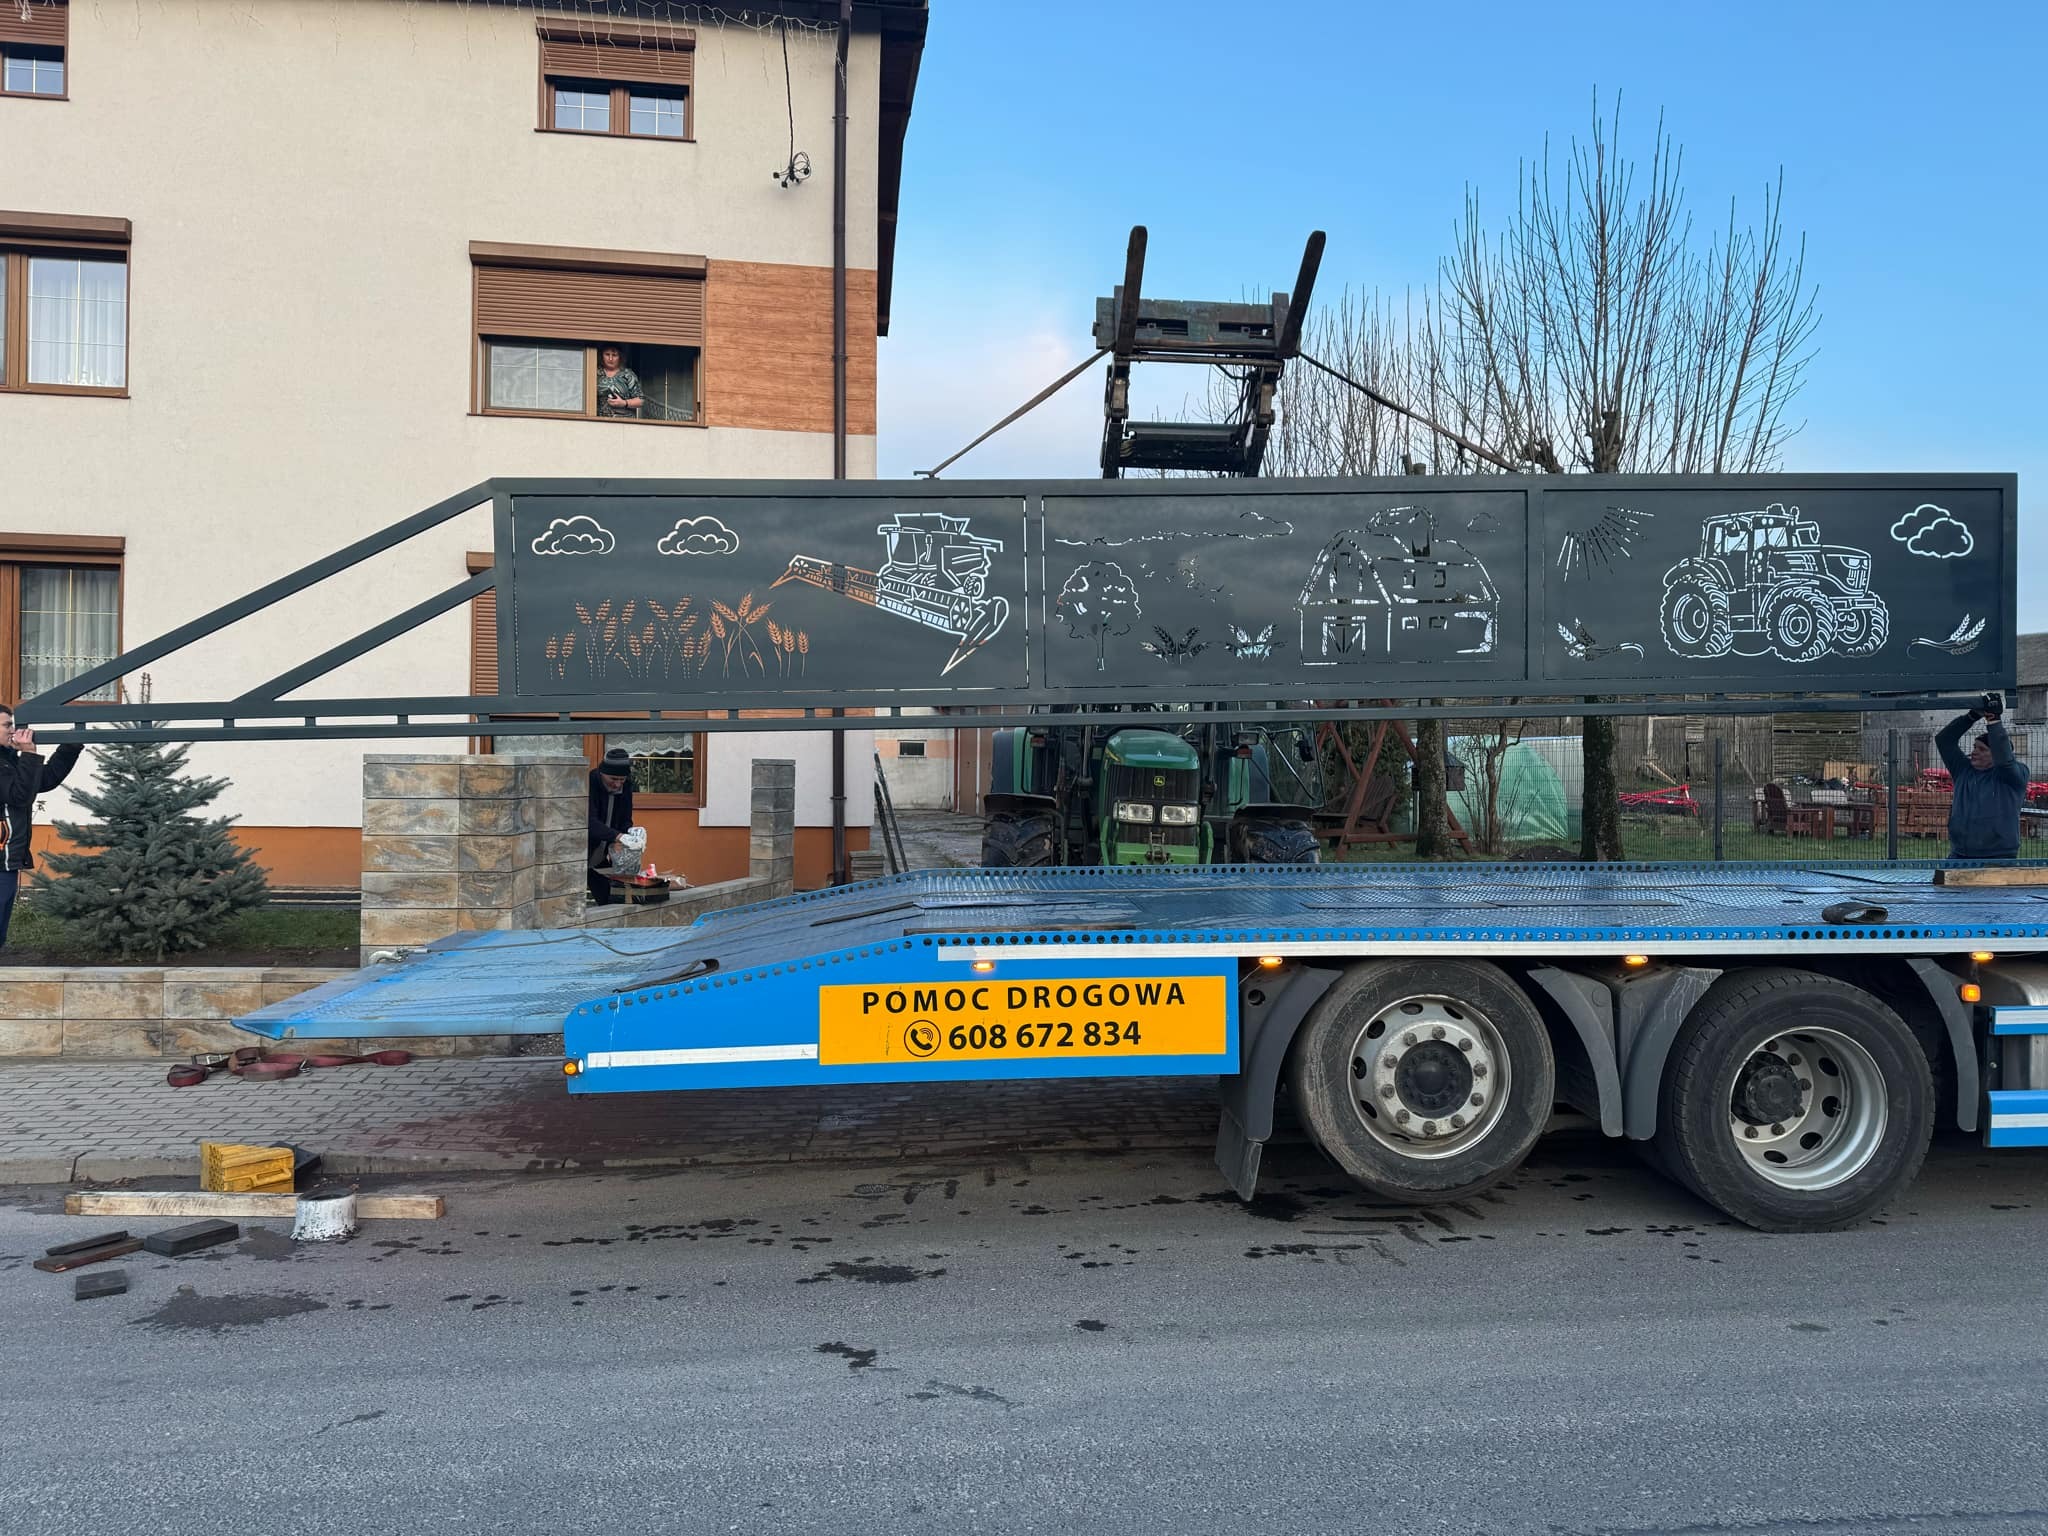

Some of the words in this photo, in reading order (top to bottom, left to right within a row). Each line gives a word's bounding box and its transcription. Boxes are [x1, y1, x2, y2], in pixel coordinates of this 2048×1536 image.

[863, 987, 989, 1015] POMOC
[1007, 982, 1185, 1010] DROGOWA
[948, 1024, 1007, 1050] 608
[1016, 1022, 1074, 1049] 672
[1083, 1021, 1142, 1047] 834
